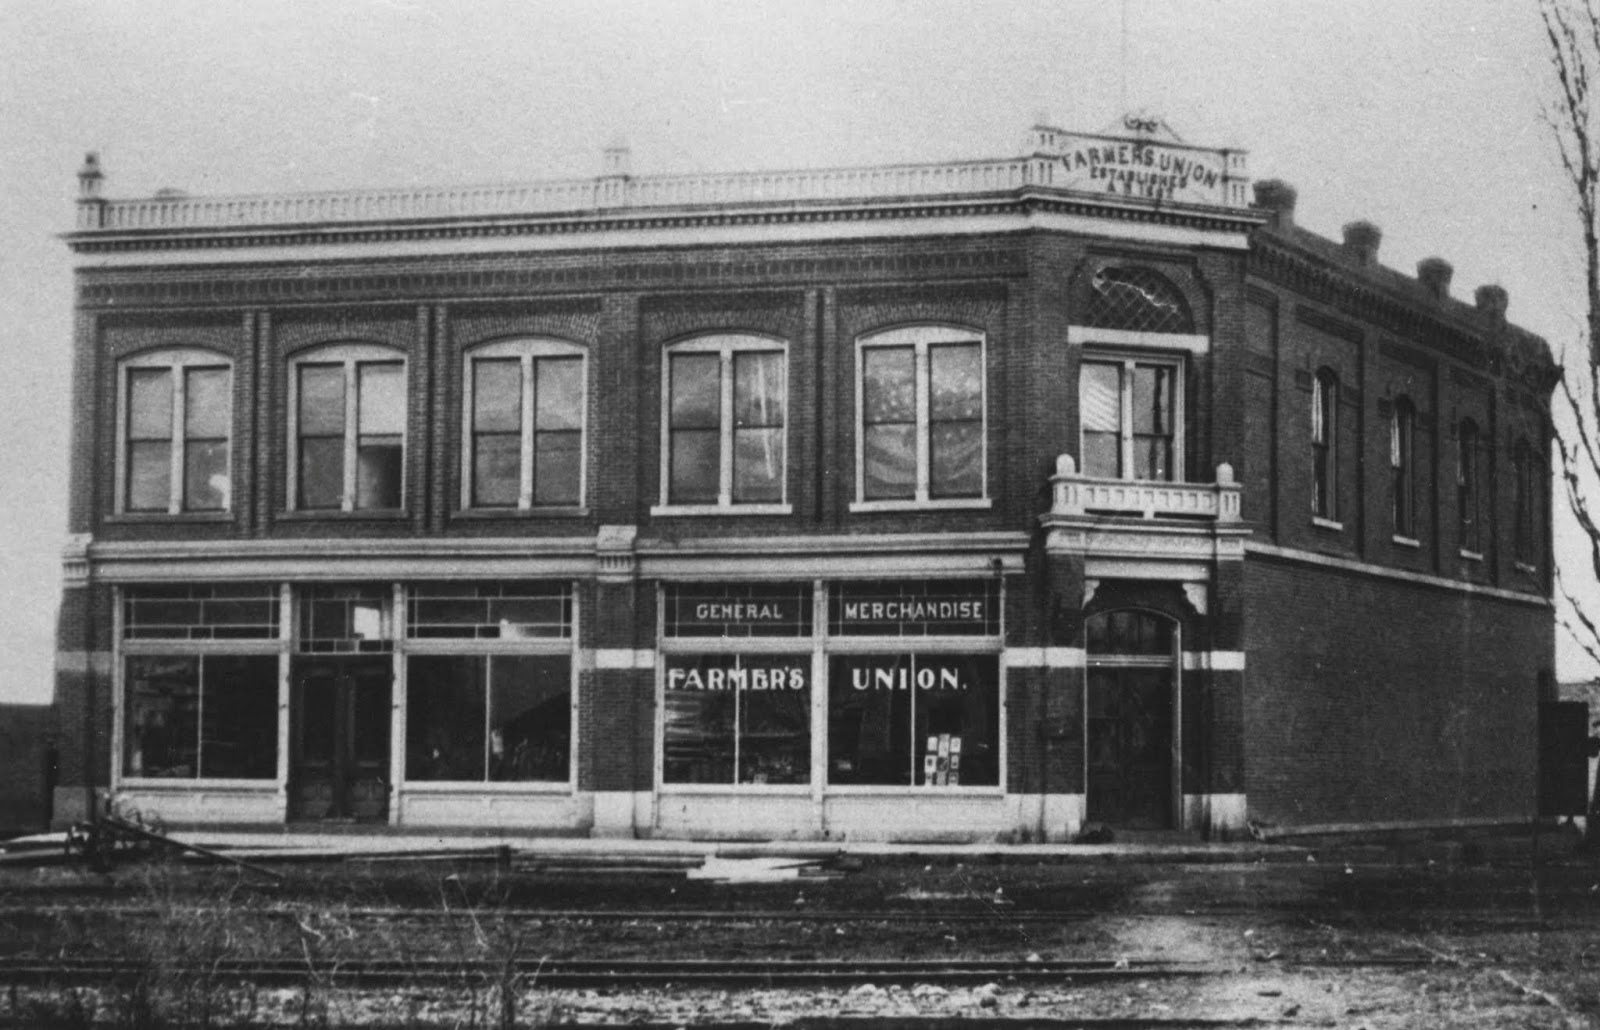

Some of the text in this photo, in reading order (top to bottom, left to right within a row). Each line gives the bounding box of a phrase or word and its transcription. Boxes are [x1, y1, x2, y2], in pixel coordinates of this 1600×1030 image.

[1061, 146, 1218, 188] FARMERS UNION
[1090, 166, 1188, 189] ESTABLISHED
[696, 601, 982, 619] GENERAL MERCHANDISE
[668, 666, 967, 690] FARMER'S UNION.
